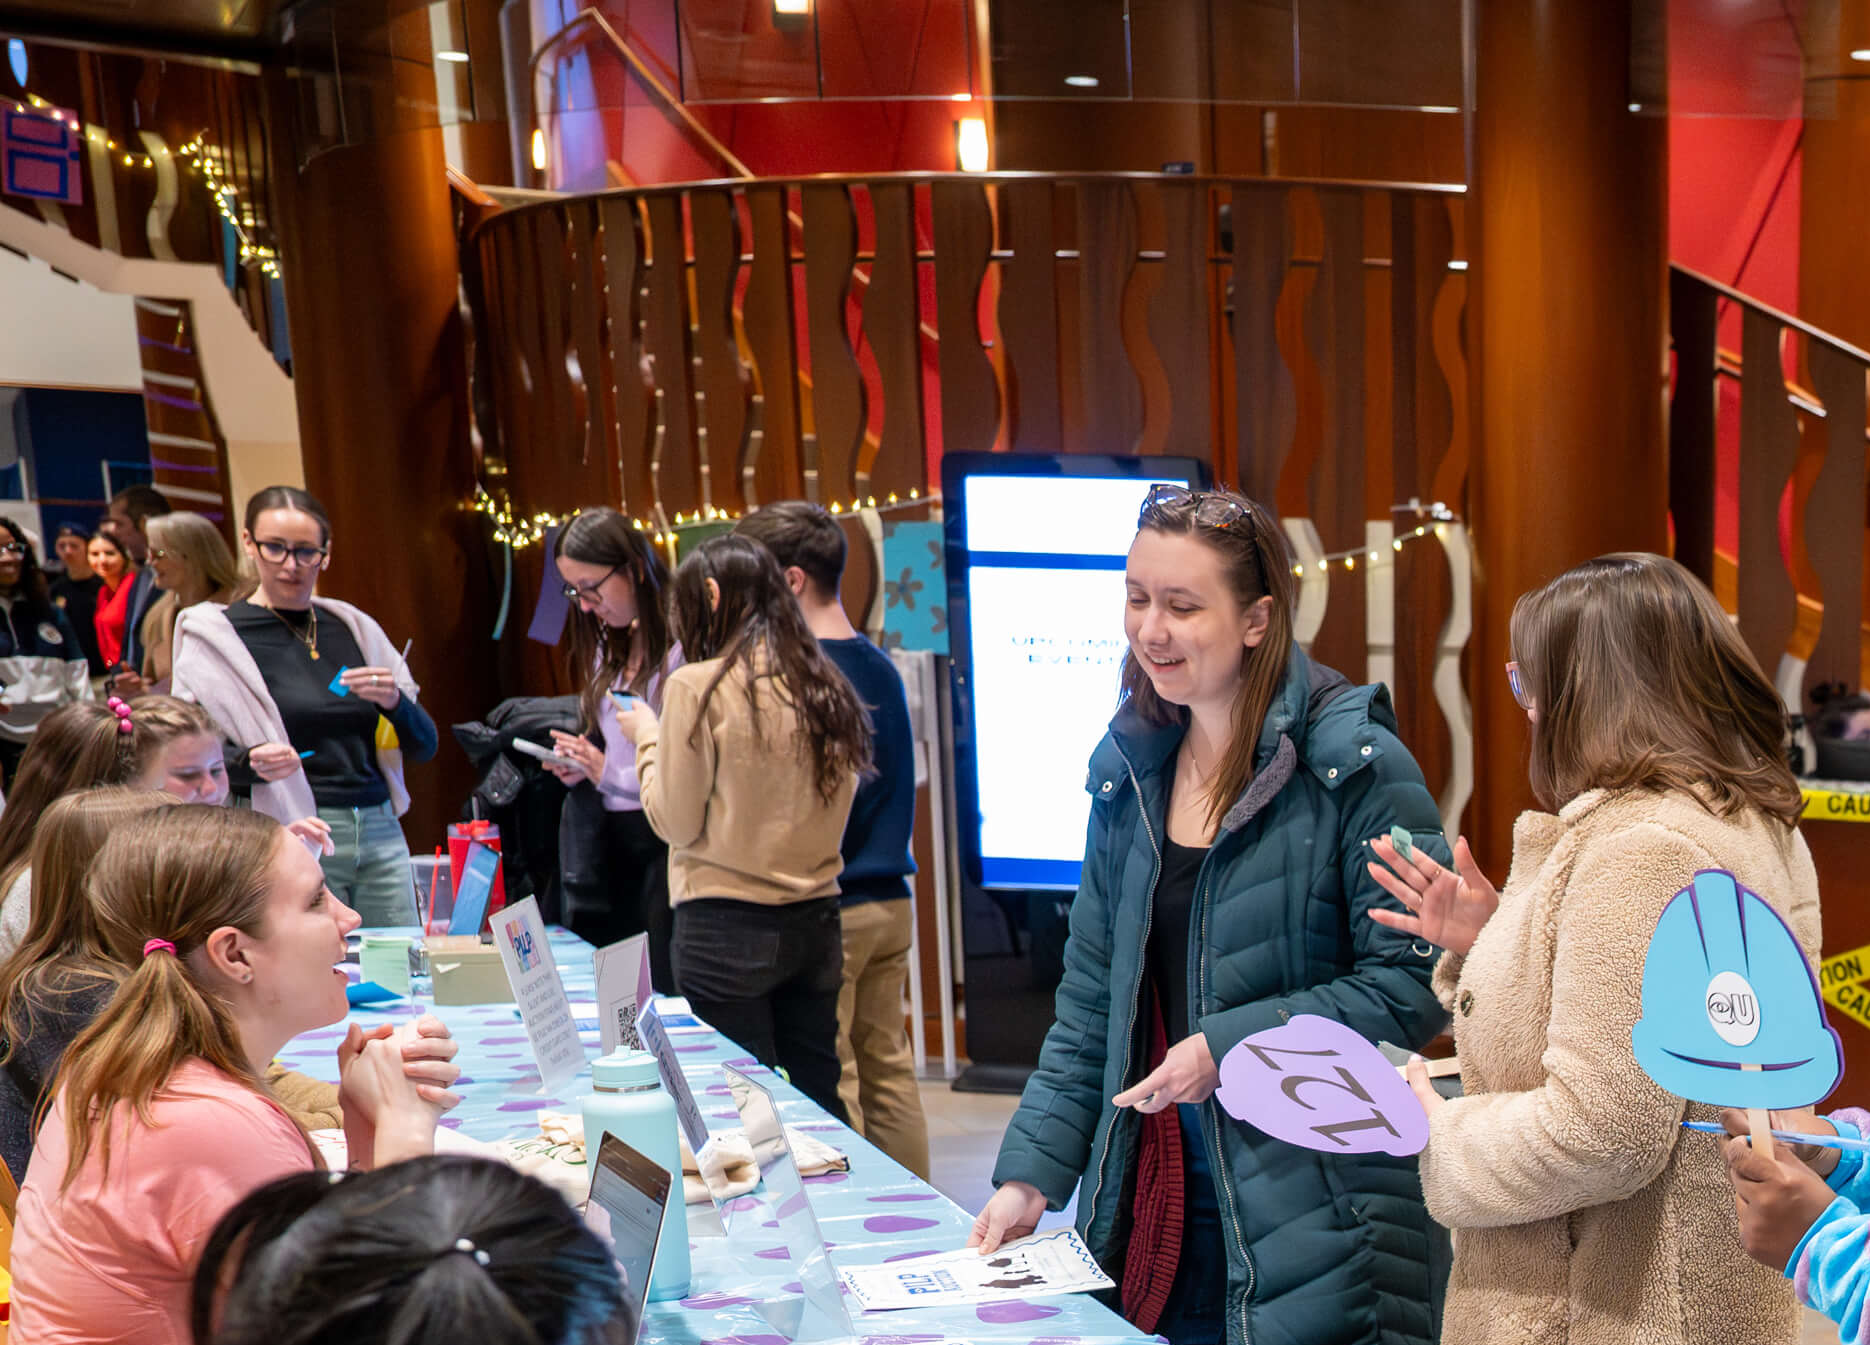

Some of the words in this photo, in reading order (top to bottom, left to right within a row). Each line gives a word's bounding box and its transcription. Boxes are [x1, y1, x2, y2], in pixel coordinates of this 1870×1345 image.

[1819, 956, 1863, 988] TION
[1708, 992, 1755, 1026] QU
[1242, 1042, 1402, 1146] 127
